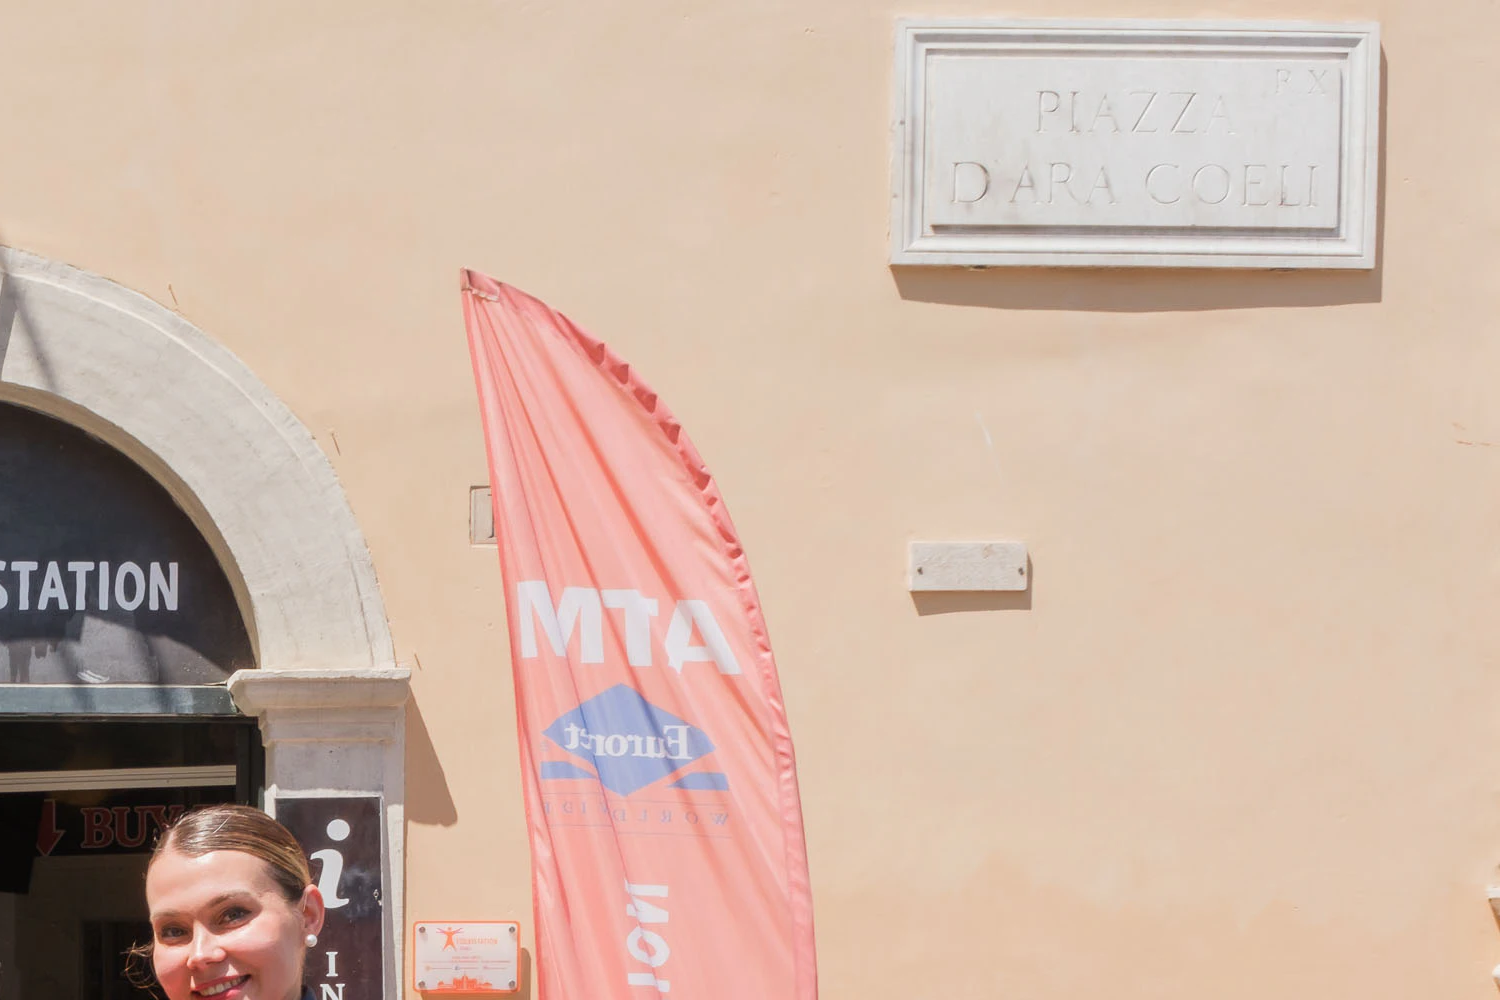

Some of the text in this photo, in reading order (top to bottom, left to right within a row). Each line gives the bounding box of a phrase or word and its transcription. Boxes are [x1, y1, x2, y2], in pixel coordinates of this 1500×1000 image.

[1307, 68, 1329, 95] X
[1036, 90, 1240, 135] PIAZZA
[1144, 162, 1319, 208] COELI
